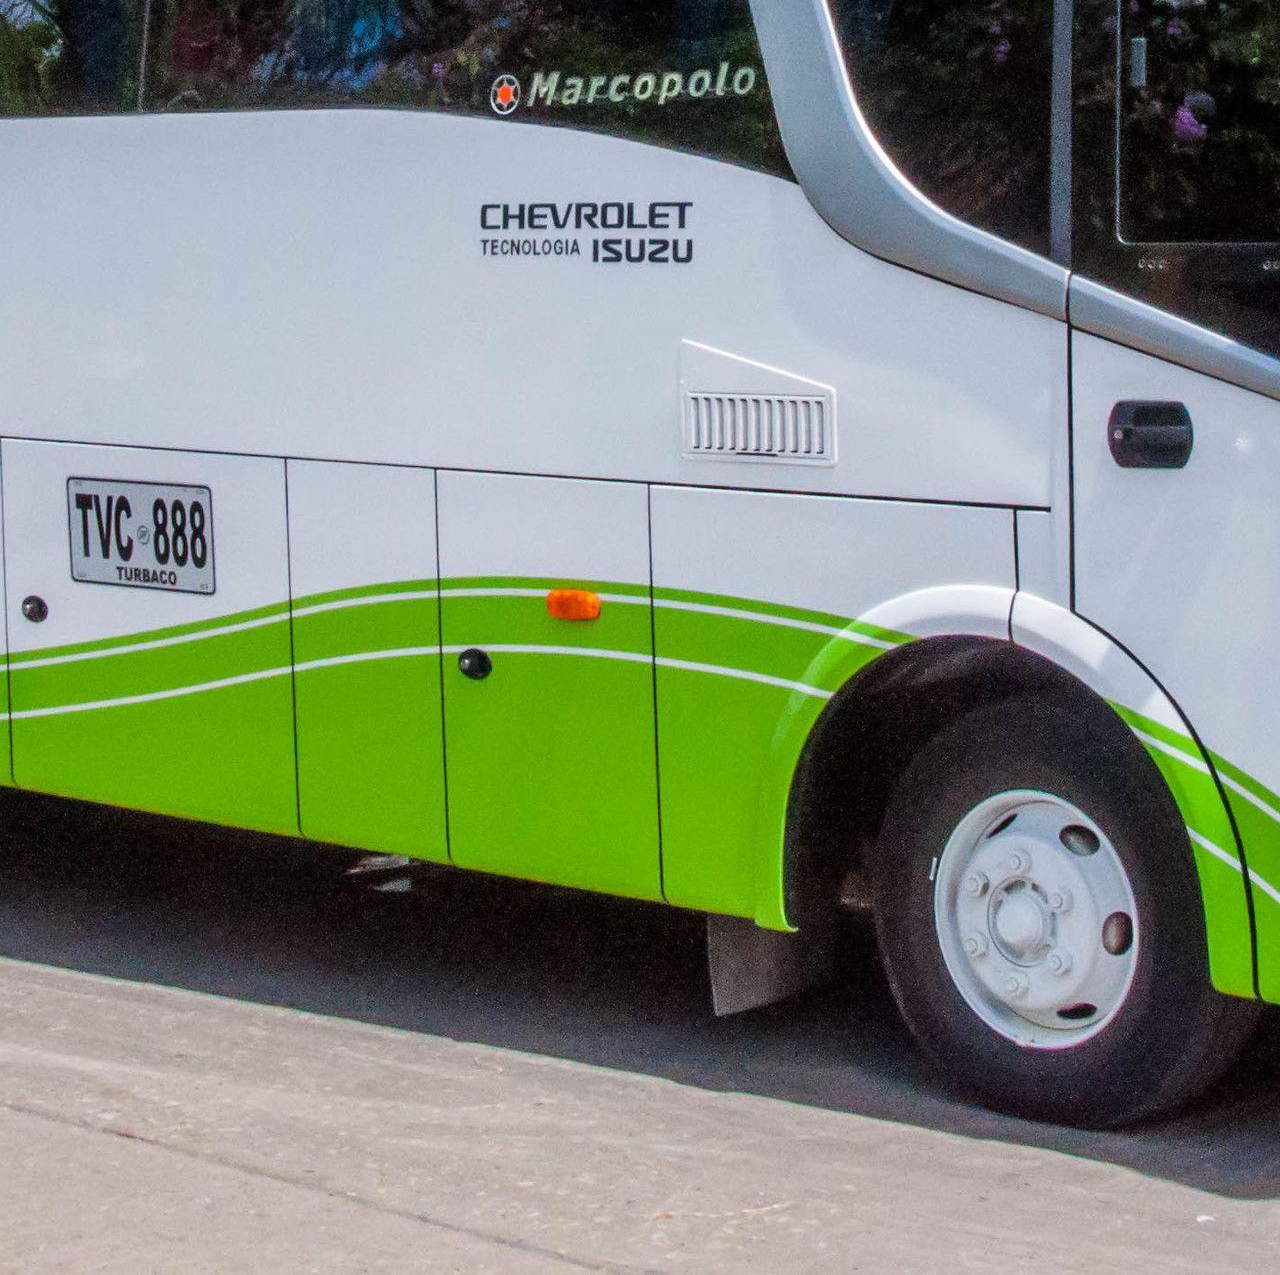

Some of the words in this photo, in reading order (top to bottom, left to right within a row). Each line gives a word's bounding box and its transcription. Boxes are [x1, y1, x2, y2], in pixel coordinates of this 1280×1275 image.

[527, 61, 755, 107] Marcopolo
[480, 202, 693, 229] CHEVROLET
[481, 239, 580, 255] TECNOLOGIA
[592, 239, 693, 263] ISUZU
[75, 493, 133, 562] TVC
[152, 498, 207, 568] 888
[116, 566, 177, 585] TURBACO
